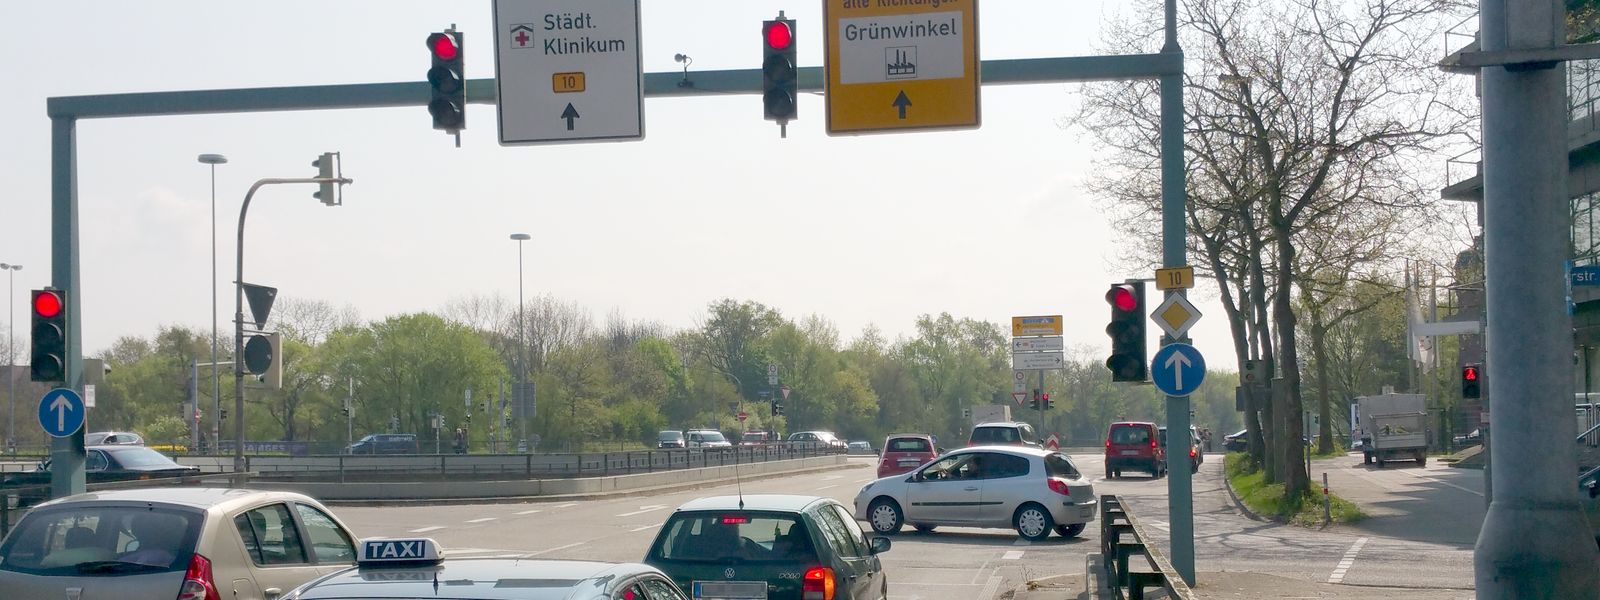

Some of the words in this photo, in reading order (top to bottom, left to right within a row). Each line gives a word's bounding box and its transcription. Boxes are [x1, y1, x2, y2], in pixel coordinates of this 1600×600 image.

[544, 13, 597, 30] Städt.
[845, 18, 957, 41] Grünwinkel
[544, 37, 625, 55] Klinikum
[562, 76, 576, 88] 10
[1168, 271, 1181, 286] 10
[369, 542, 423, 558] TAXI
